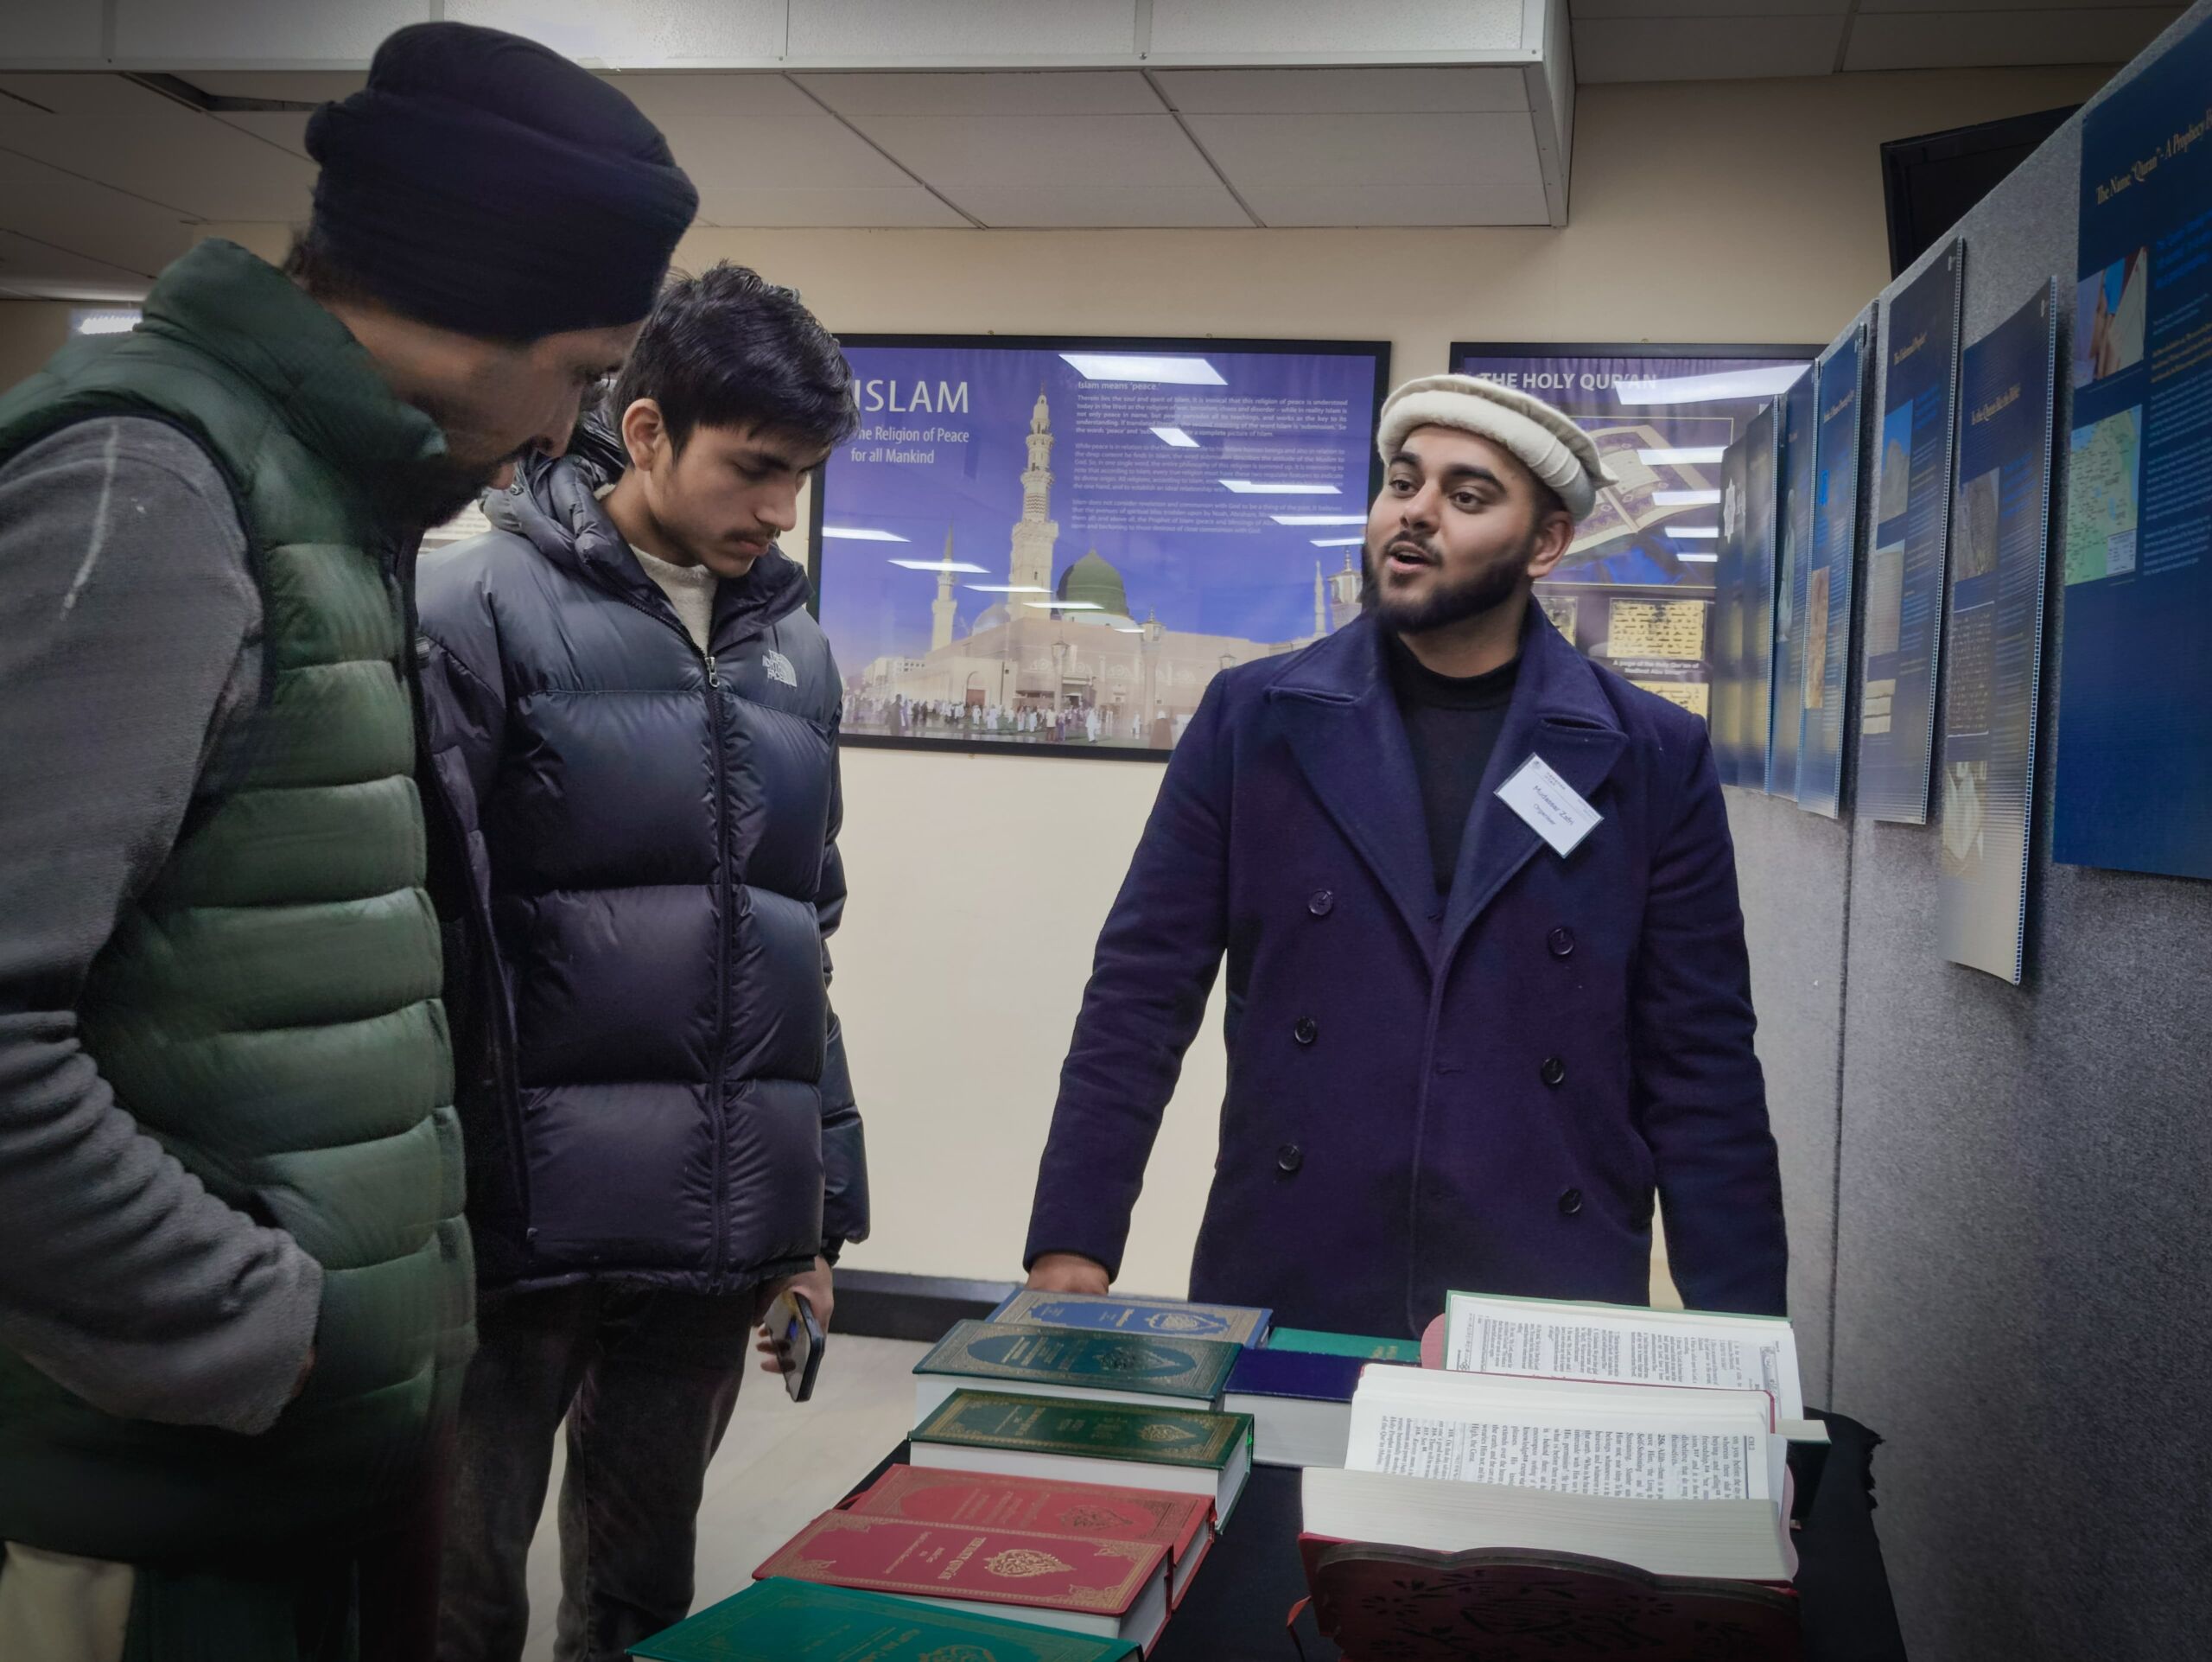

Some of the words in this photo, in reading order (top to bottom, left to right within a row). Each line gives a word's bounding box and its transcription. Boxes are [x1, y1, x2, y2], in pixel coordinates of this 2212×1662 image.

[1522, 373, 1575, 389] HOLY
[854, 379, 969, 413] ISLAM
[875, 426, 919, 444] Religion
[923, 428, 936, 442] of
[938, 428, 969, 443] Peace
[851, 448, 866, 462] for
[868, 448, 882, 462] all
[886, 449, 935, 464] Mankind
[1604, 1431, 1612, 1452] belongs
[1711, 1436, 1719, 1455] buying
